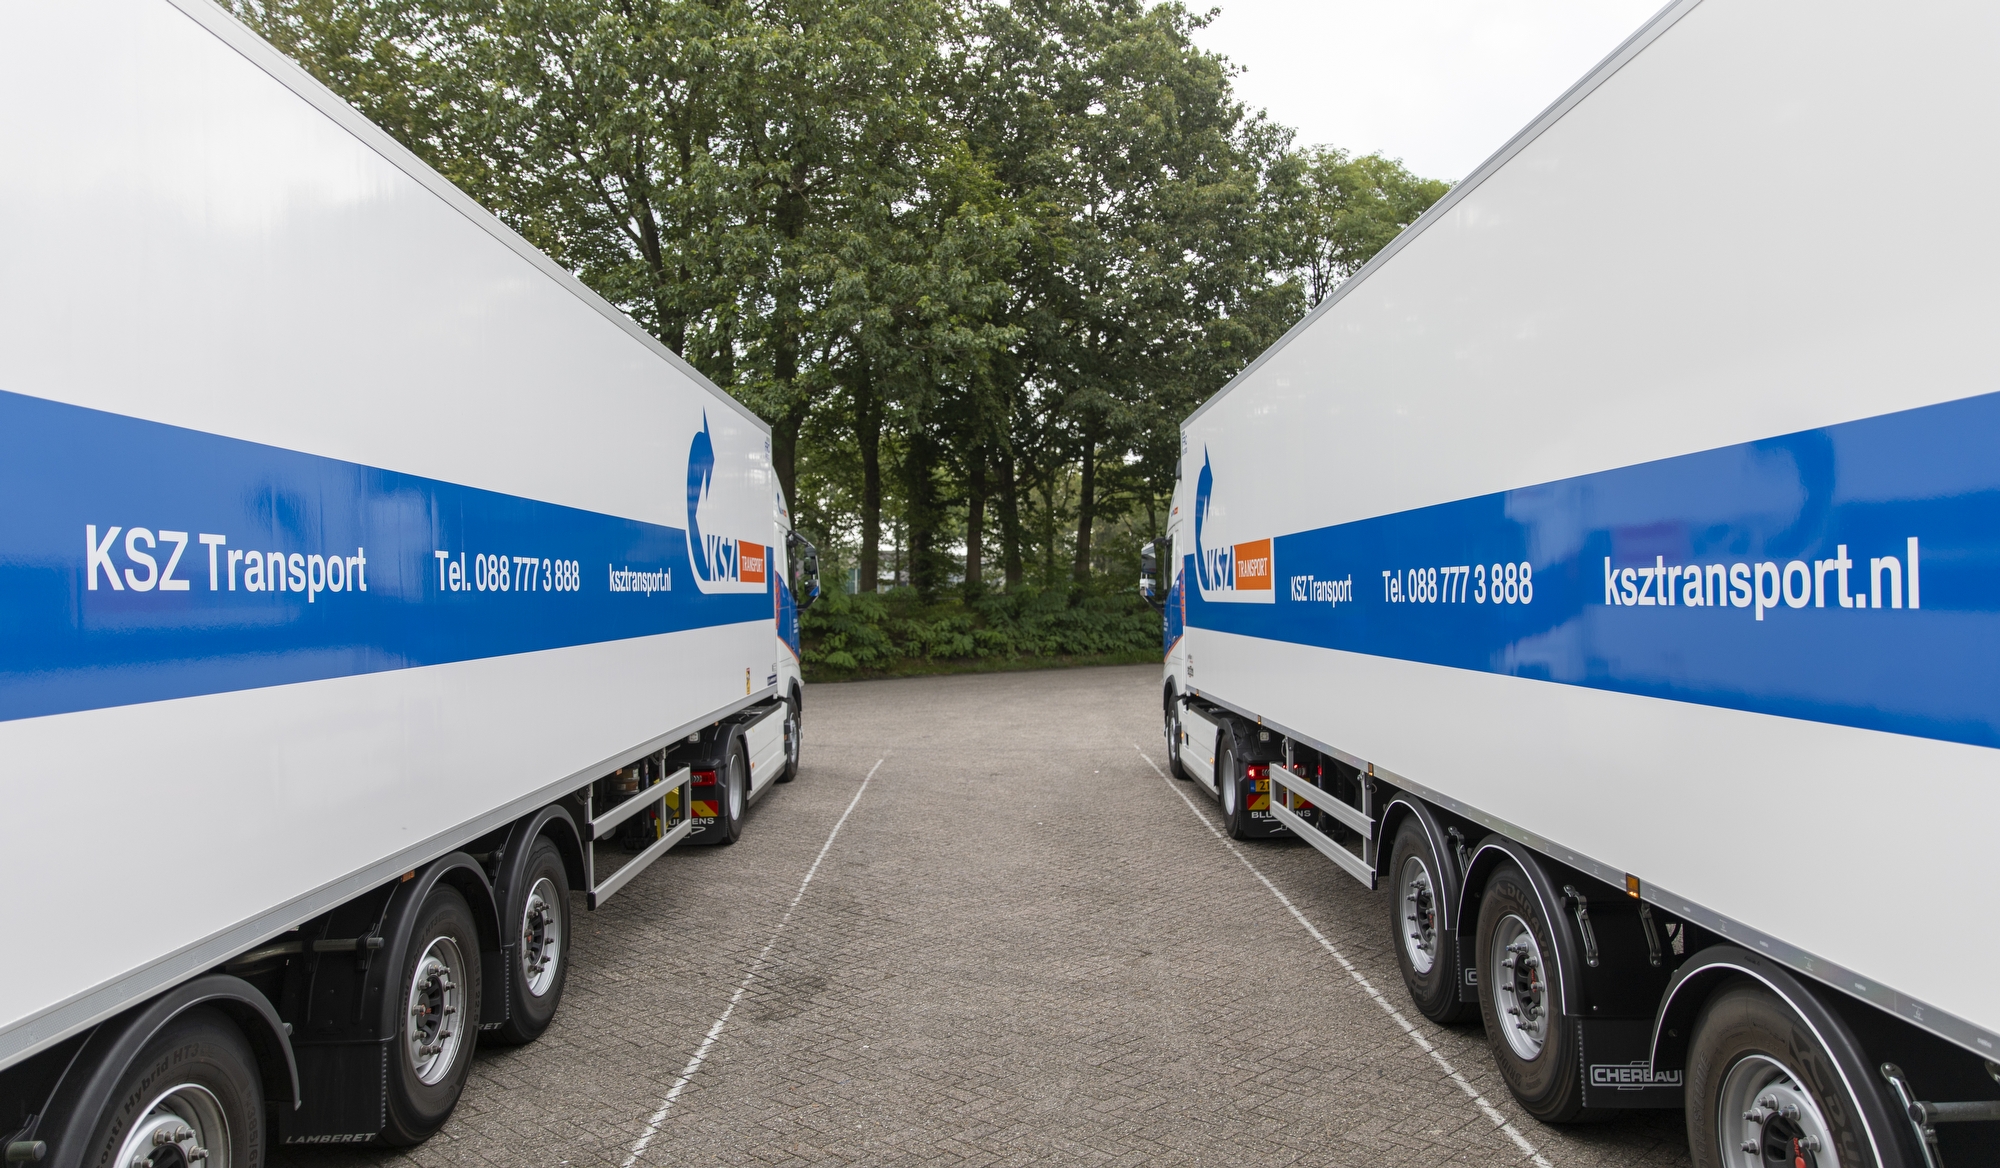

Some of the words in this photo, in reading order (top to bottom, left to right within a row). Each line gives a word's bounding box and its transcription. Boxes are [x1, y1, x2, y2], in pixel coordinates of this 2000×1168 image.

[86, 524, 190, 592] KSZ
[199, 533, 367, 603] Transport
[434, 550, 471, 592] Tel.
[475, 553, 510, 592] 088
[513, 556, 539, 592] 777
[542, 558, 552, 592] 3
[554, 559, 580, 592] 888
[609, 563, 672, 597] ksztransport.nl
[709, 535, 738, 582] KSZ
[741, 555, 764, 573] TRANSPORT
[1208, 545, 1234, 591] KSZ
[1237, 557, 1268, 578] TRANSPORT
[1604, 536, 1920, 621] ksztransport.nl
[1291, 575, 1308, 602] KSZ
[1308, 573, 1352, 608] Transport
[1382, 569, 1405, 603] Tel.
[1408, 567, 1438, 603] 088
[1440, 565, 1470, 603] 777
[1474, 564, 1487, 604] 3
[1491, 561, 1533, 605] 888
[97, 1118, 123, 1168] onti
[285, 1132, 377, 1144] LAMBERET
